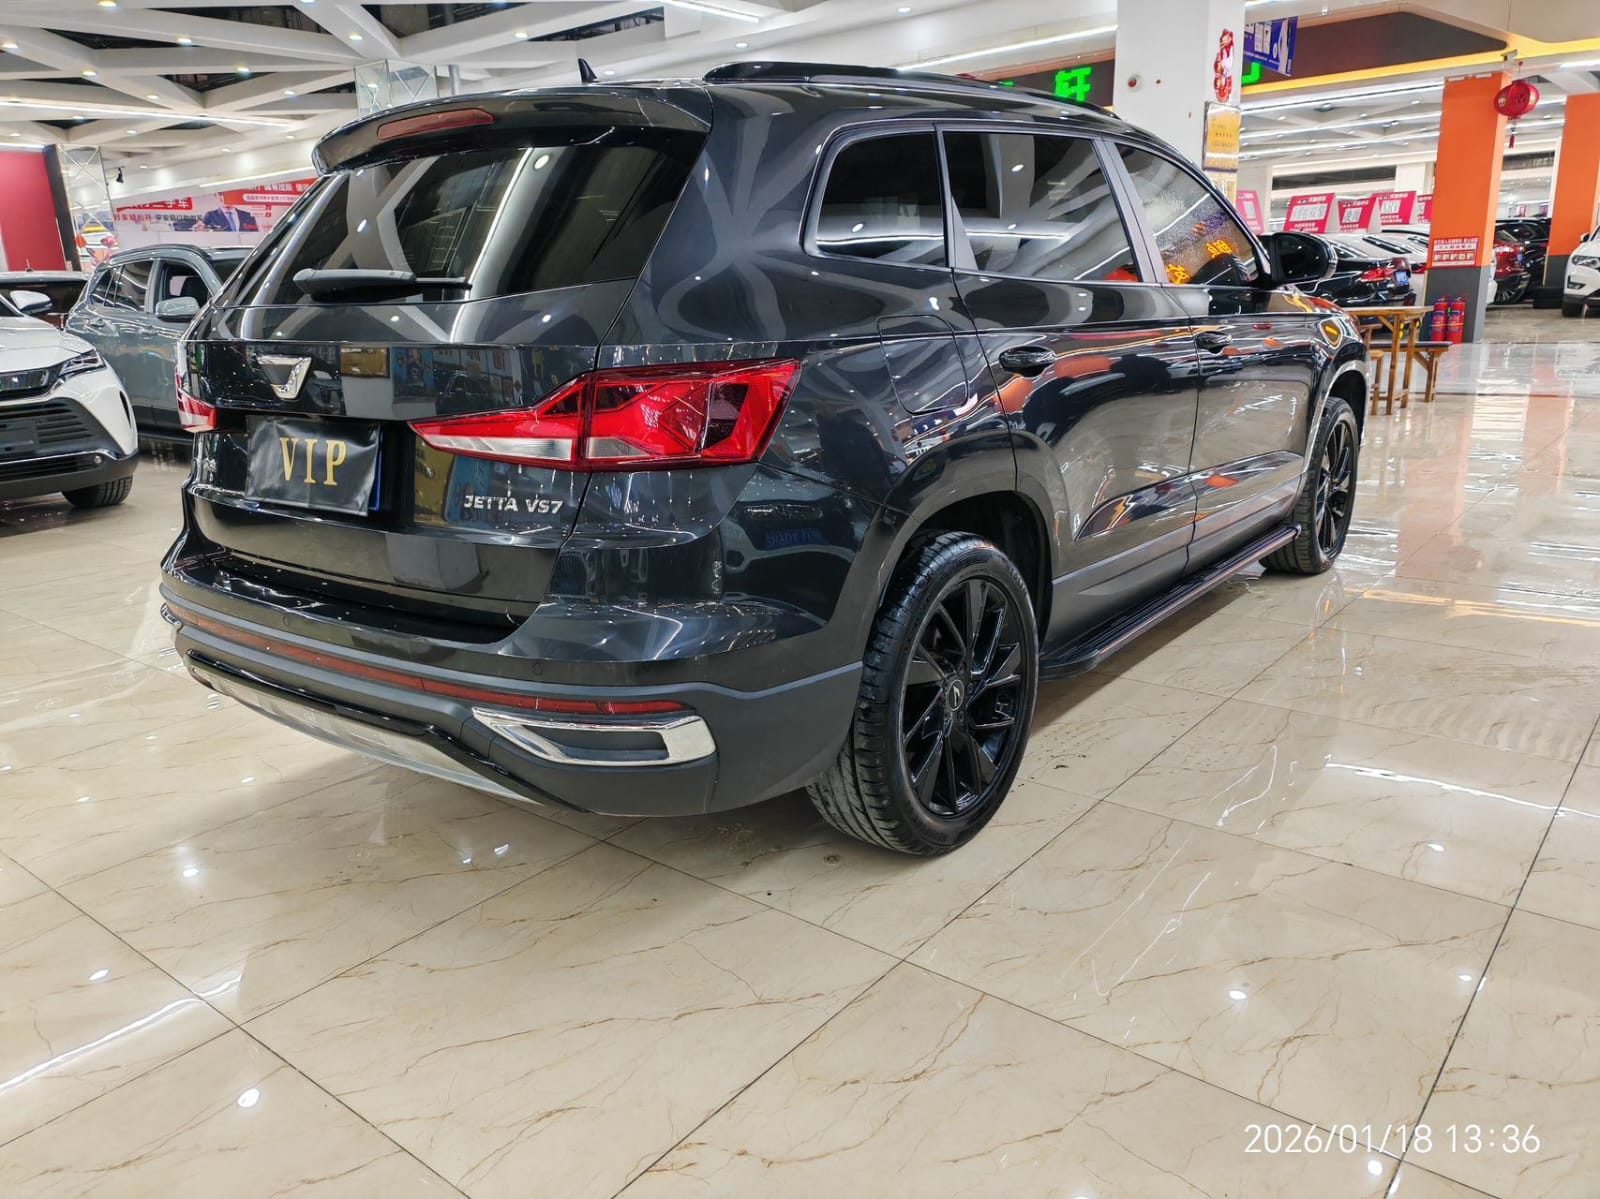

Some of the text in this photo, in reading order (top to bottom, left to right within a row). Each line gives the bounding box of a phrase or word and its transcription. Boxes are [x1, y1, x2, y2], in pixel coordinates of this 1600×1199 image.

[279, 437, 346, 486] VIP
[464, 495, 563, 514] JETTA VS7
